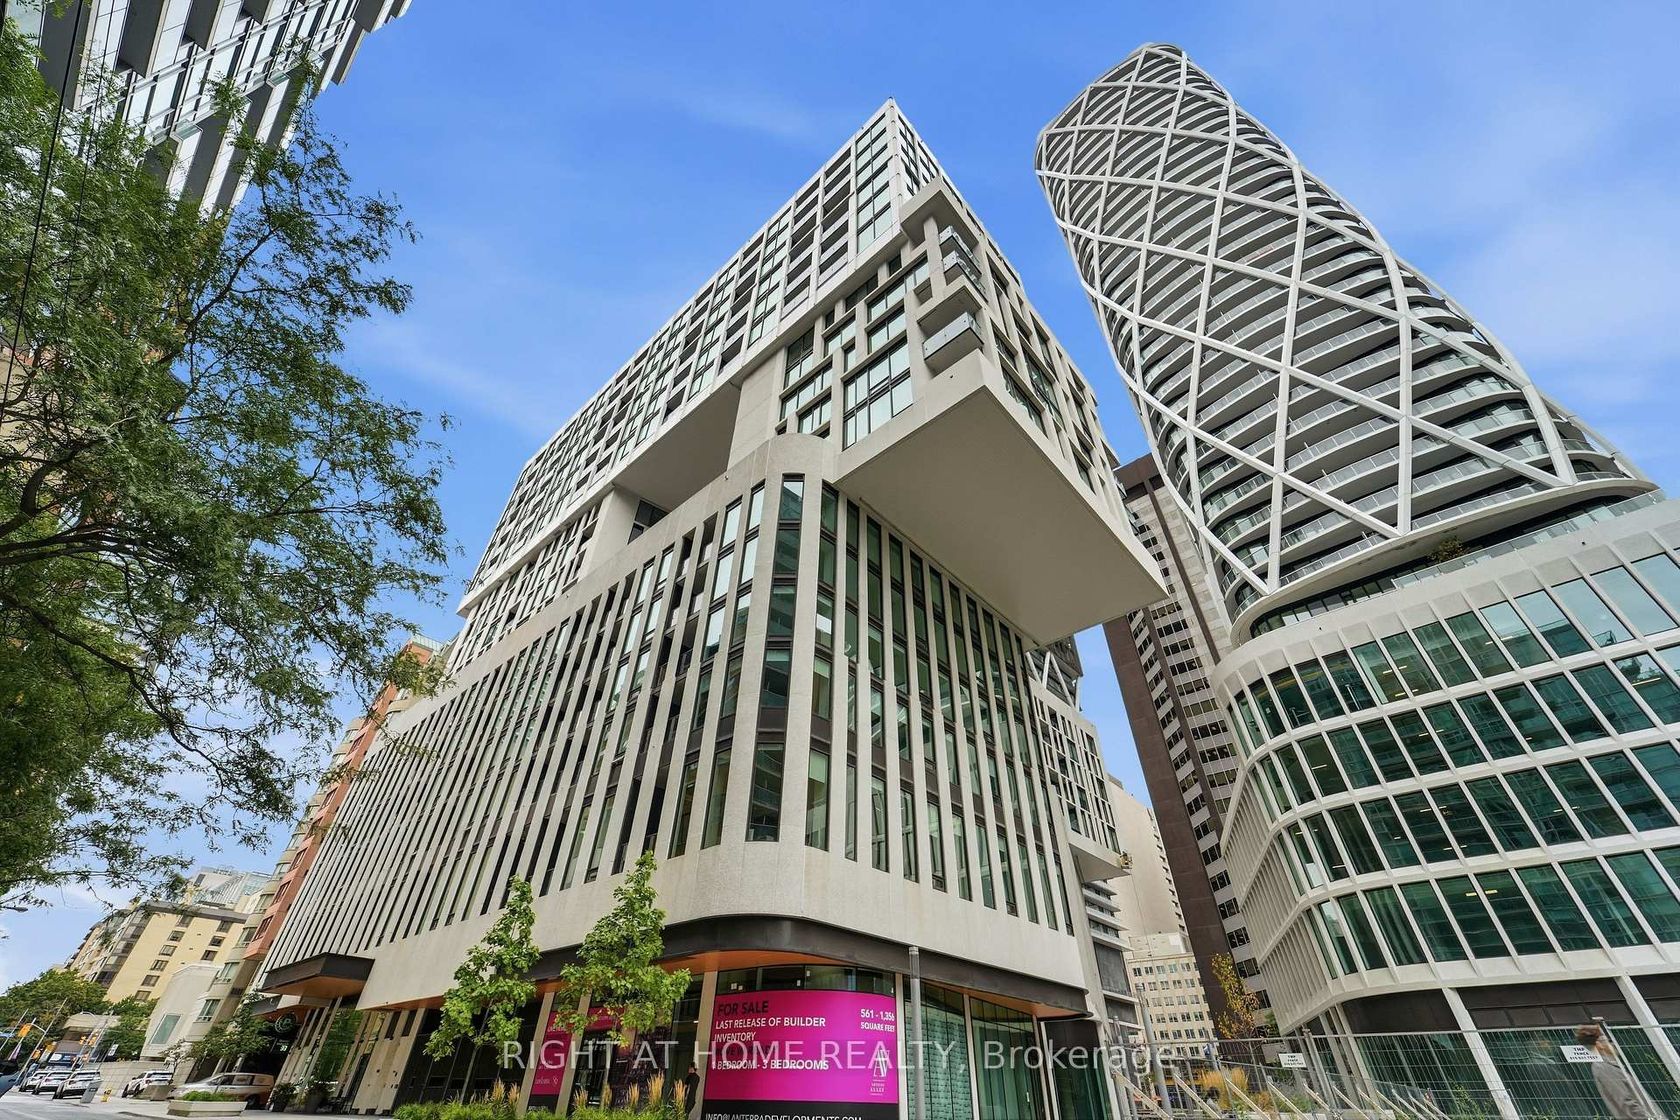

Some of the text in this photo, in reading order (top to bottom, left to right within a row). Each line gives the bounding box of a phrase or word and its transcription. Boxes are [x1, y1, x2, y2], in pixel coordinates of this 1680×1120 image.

[717, 1000, 768, 1016] FOR SALE
[860, 1008, 874, 1019] 561
[715, 1017, 826, 1030] LAST RELEASE OF BUILDER
[860, 1021, 884, 1031] SQUARE
[714, 1032, 756, 1043] INVENTORY
[717, 1060, 757, 1070] BEDROOM
[762, 1060, 768, 1069] 3
[770, 1060, 829, 1070] BEDROOMS
